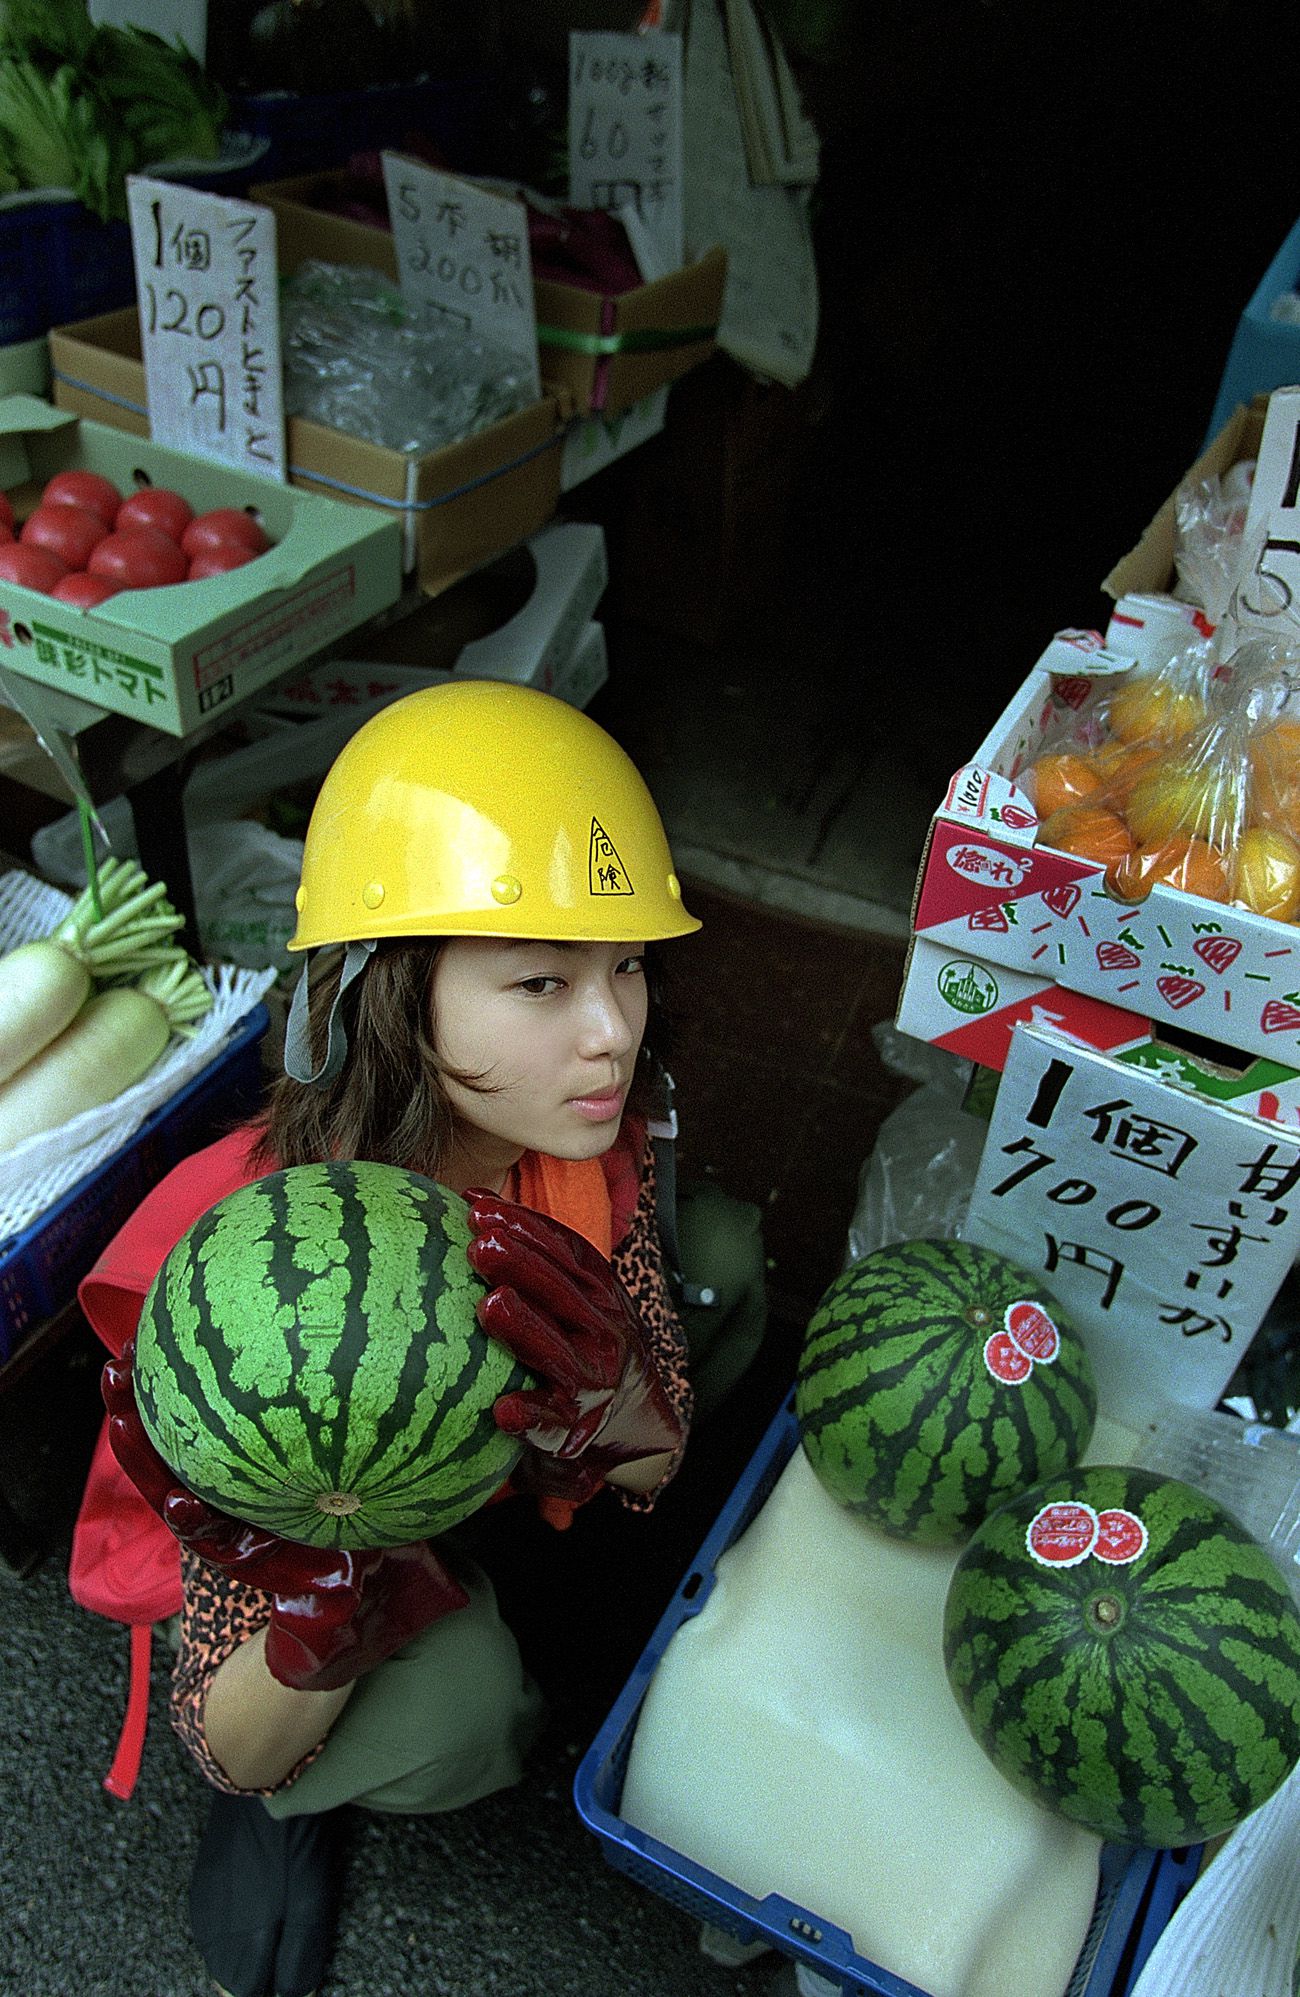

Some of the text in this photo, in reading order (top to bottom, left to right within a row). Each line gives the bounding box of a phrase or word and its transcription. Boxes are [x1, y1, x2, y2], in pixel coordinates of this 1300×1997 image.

[151, 200, 211, 271] 1個
[146, 283, 226, 340] 120
[185, 359, 226, 433] 円
[1025, 1058, 1199, 1180] 1個
[990, 1136, 1161, 1231] 700
[1043, 1232, 1126, 1310] 円
